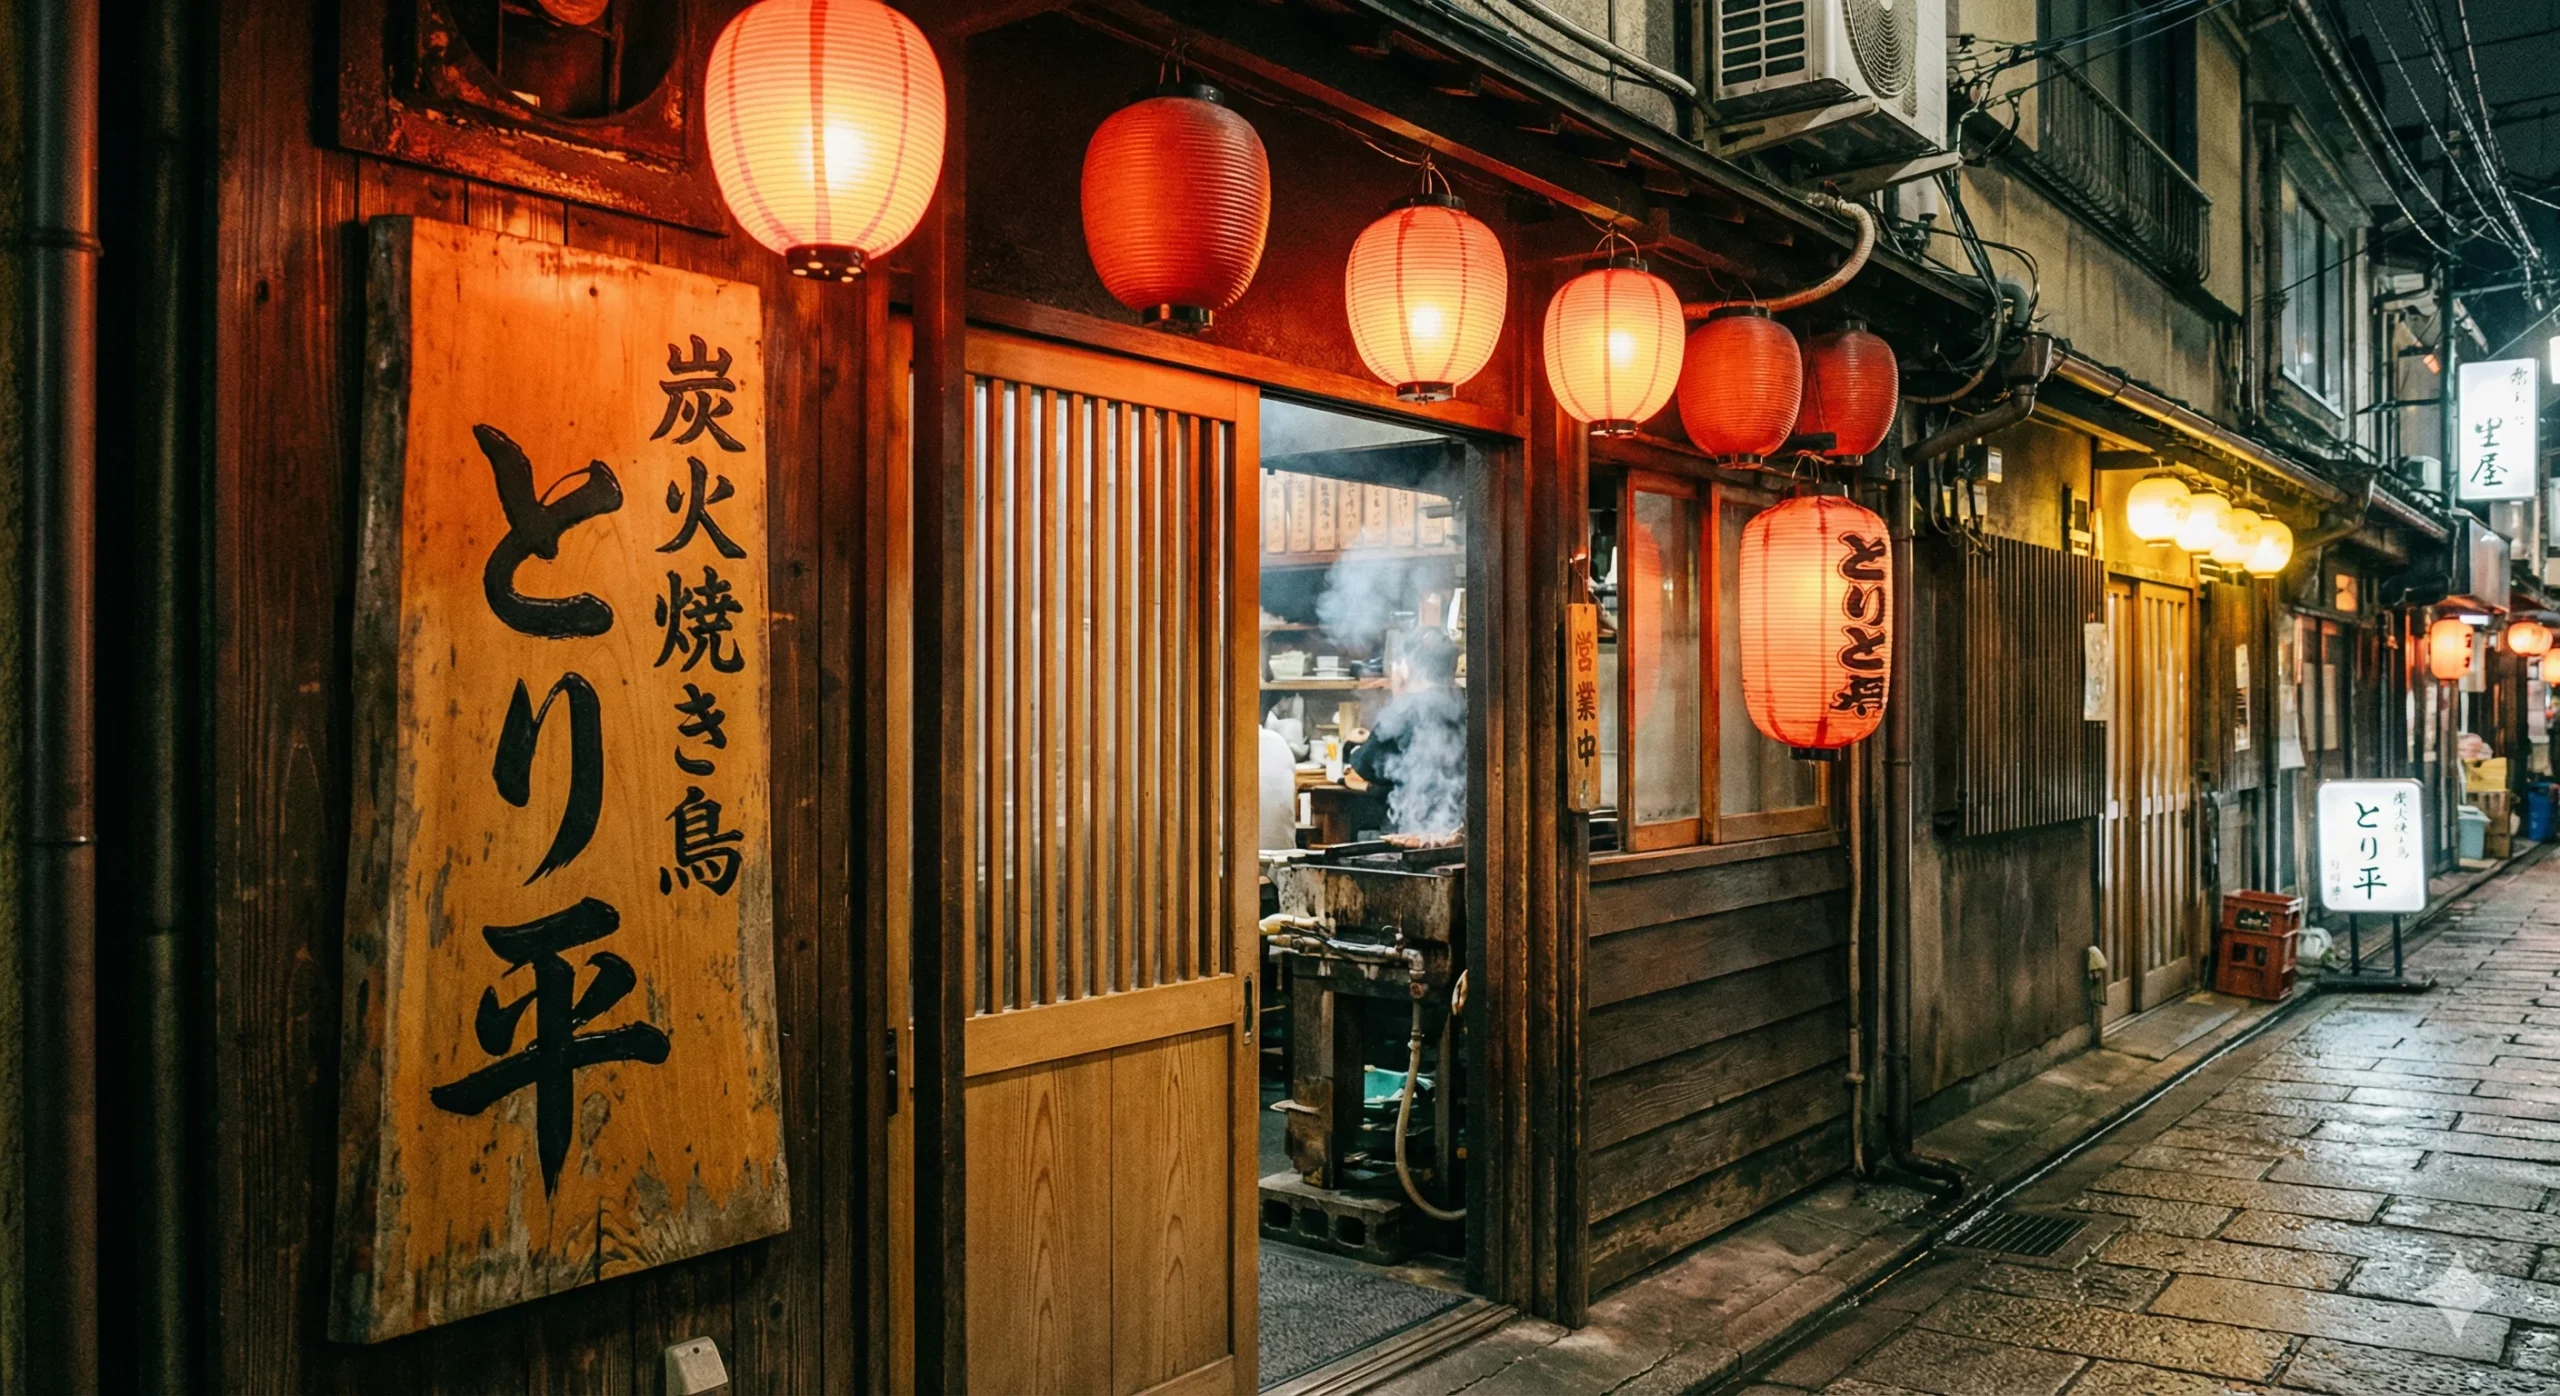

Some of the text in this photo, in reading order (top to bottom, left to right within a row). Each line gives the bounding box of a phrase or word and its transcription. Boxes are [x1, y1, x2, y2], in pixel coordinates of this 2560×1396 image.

[650, 333, 745, 898] 炭火焼き鳥
[1575, 630, 1597, 768] 営業中
[430, 422, 671, 1199] とり平
[2353, 801, 2388, 900] とり平
